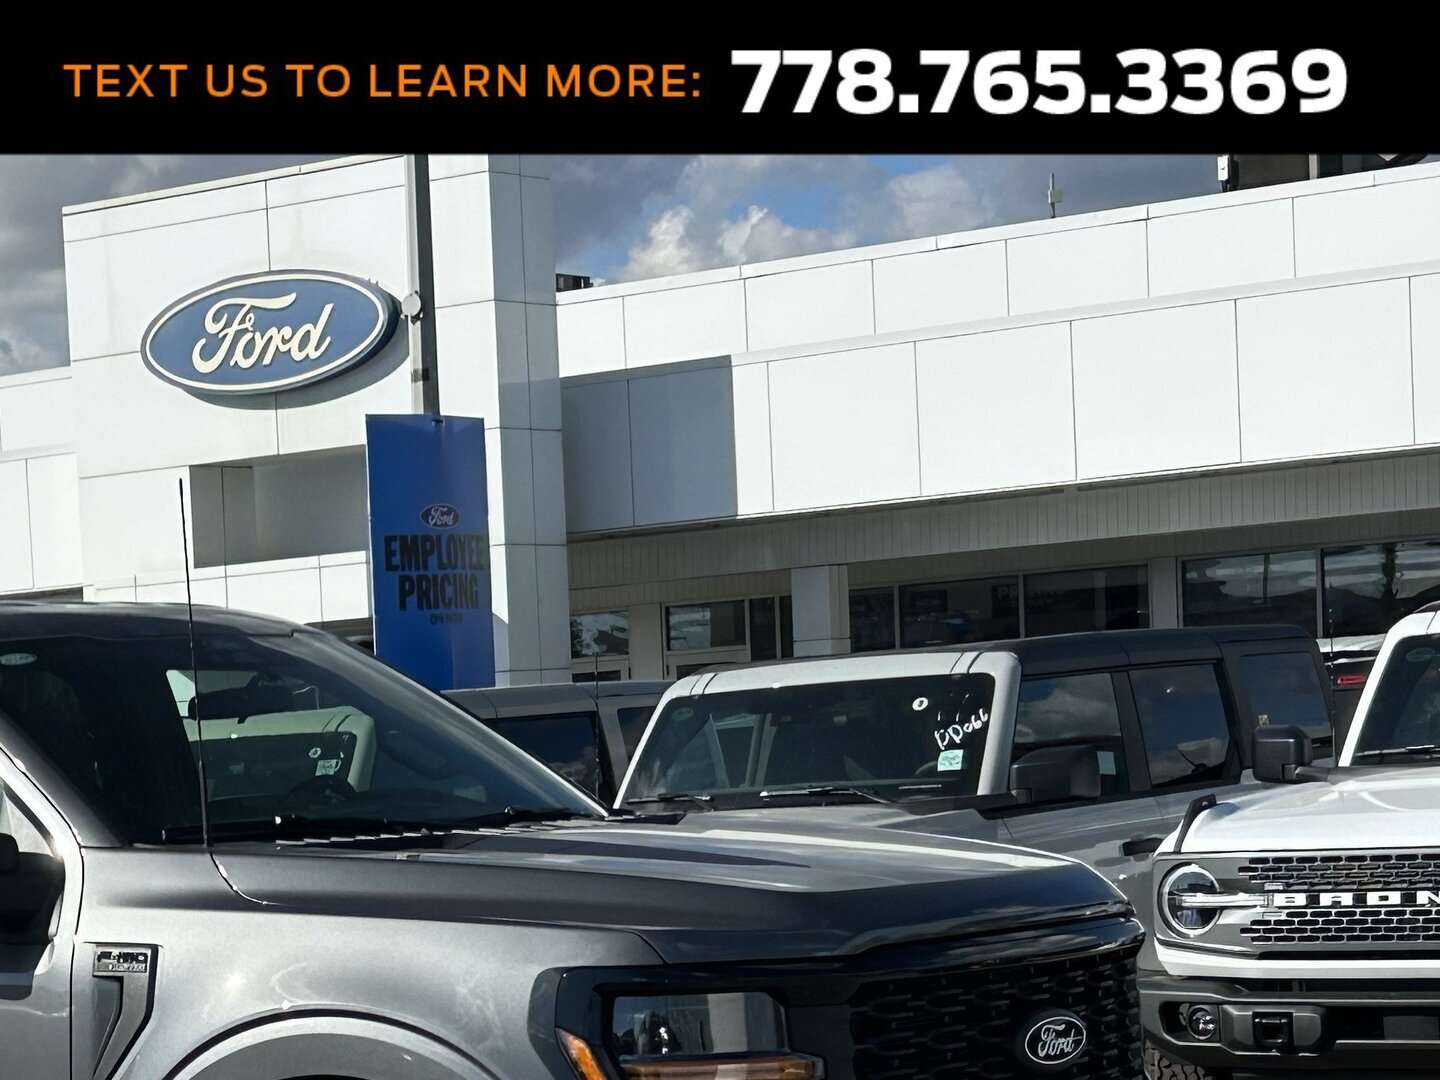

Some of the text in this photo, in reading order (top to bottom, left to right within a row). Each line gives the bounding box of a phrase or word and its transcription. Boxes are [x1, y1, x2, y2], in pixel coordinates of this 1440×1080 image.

[192, 292, 334, 374] Ford
[428, 506, 455, 526] Ford
[398, 574, 480, 611] PRICING
[1037, 1024, 1083, 1058] Ford
